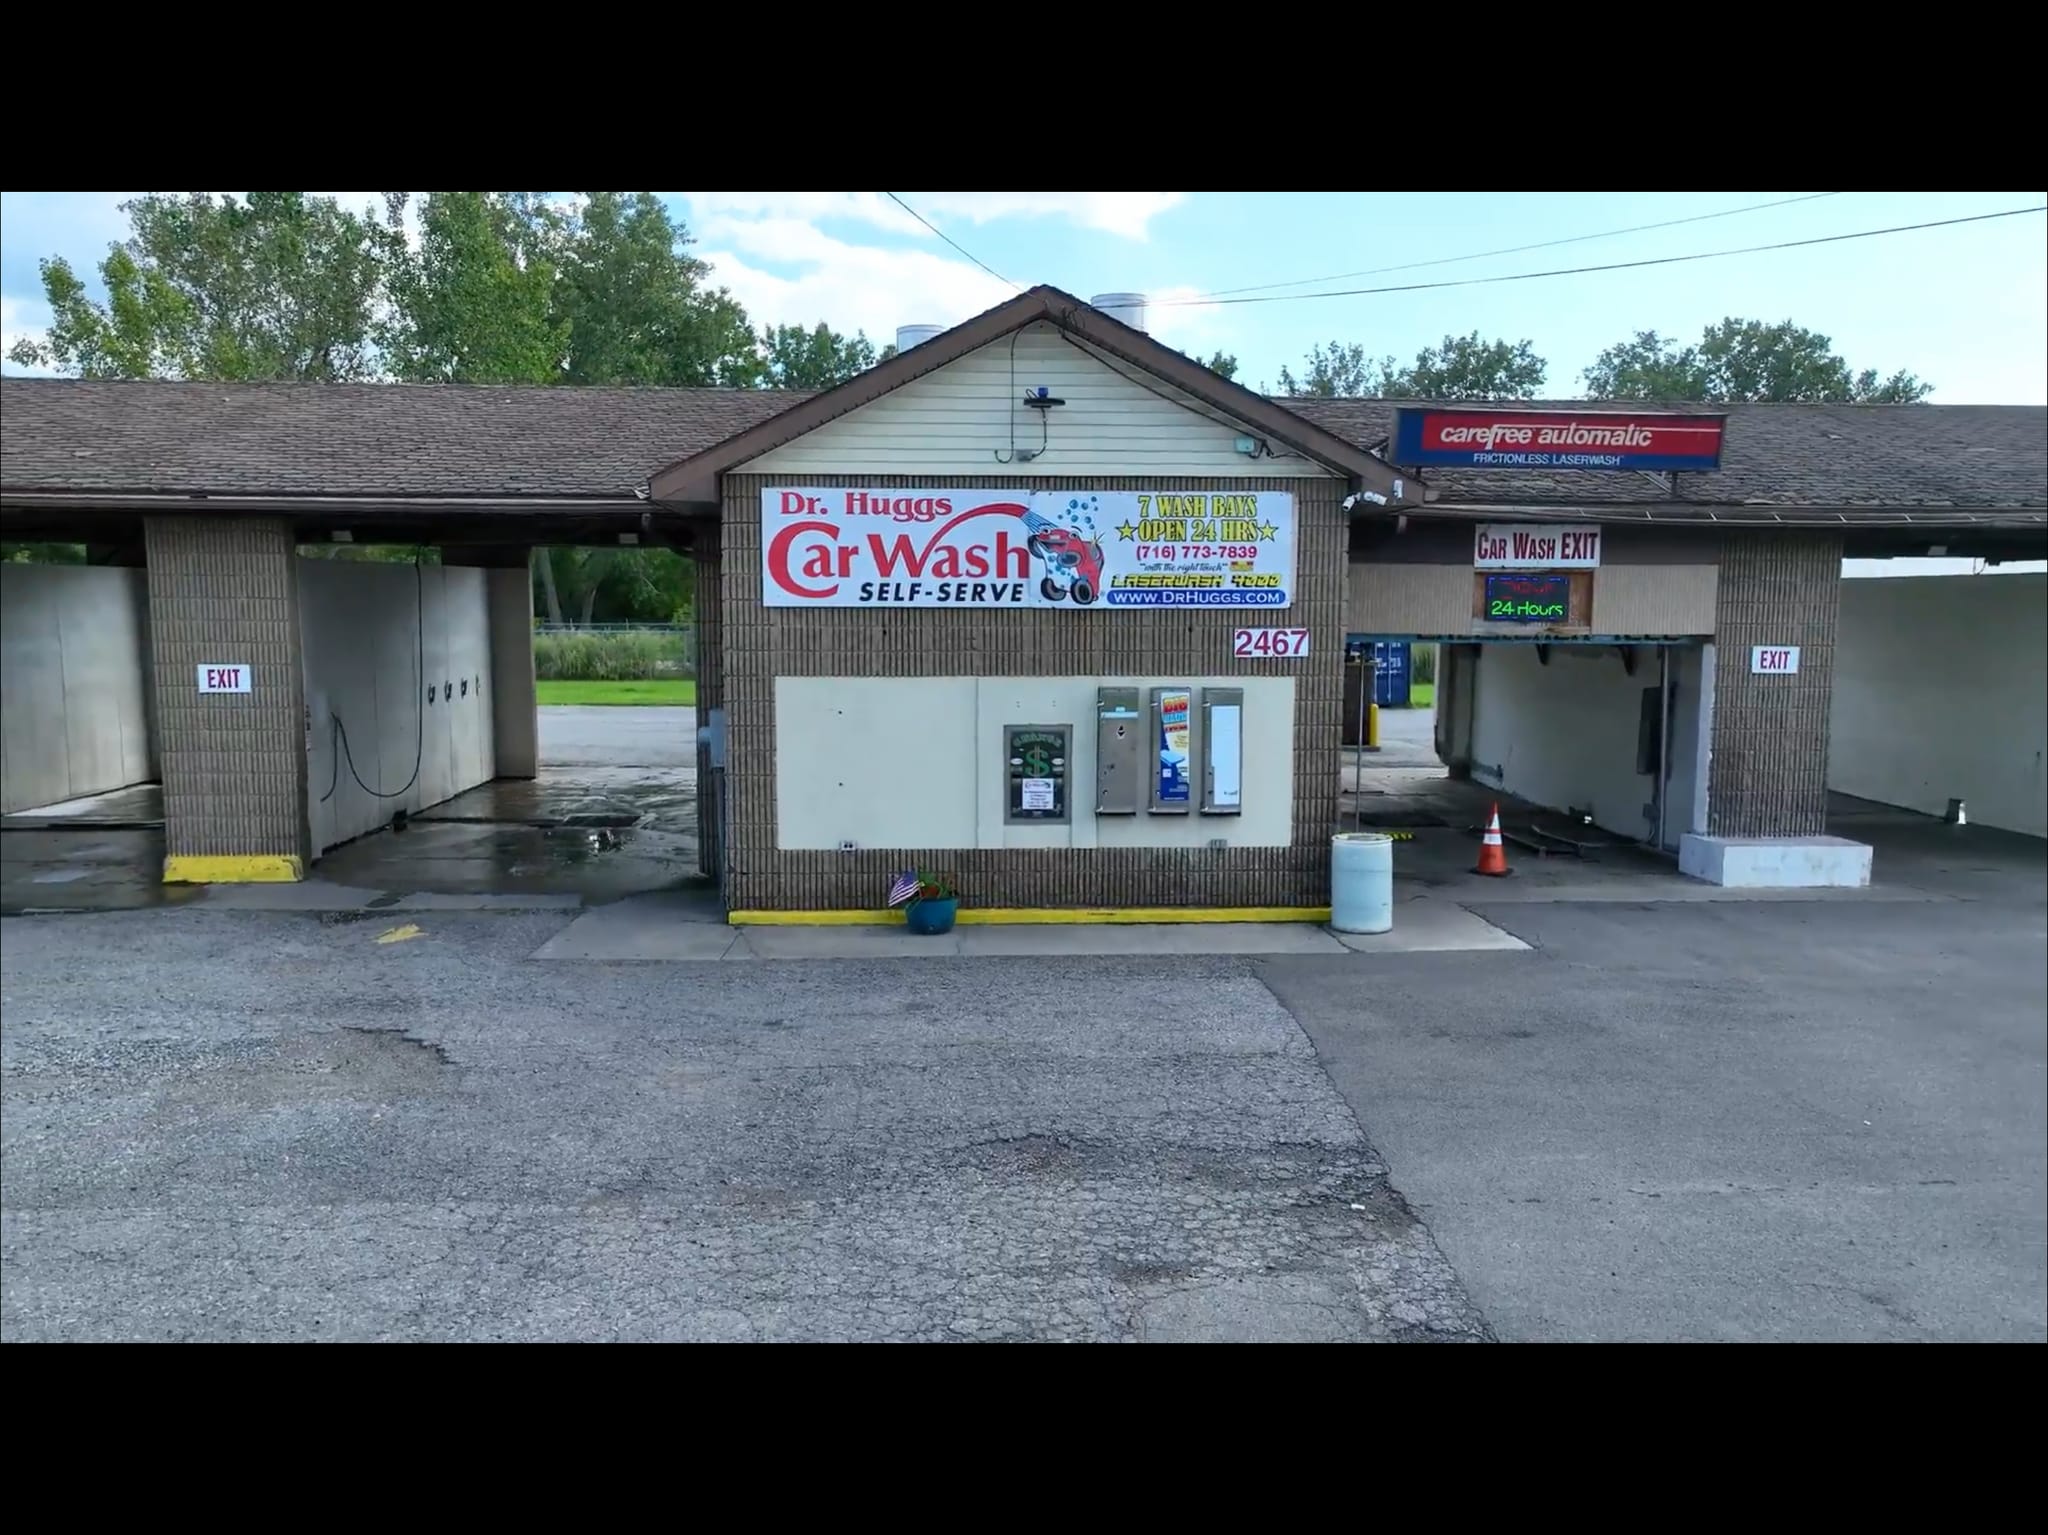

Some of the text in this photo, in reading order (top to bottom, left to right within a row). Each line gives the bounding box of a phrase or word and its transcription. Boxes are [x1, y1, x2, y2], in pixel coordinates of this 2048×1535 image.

[1440, 423, 1653, 450] carefree automatic
[1473, 452, 1620, 466] FRICTIONLESS LASERWASH
[780, 491, 952, 522] Dr. Huggs
[1138, 495, 1258, 518] 7 WASH BAYS
[1137, 519, 1259, 542] OPEN 24 HRS
[1136, 545, 1258, 561] (716) 773-7839
[1560, 532, 1599, 560] EXIT
[768, 521, 1030, 599] Car Wash
[1111, 573, 1225, 589] LASERWASH
[859, 582, 1024, 602] SELF-SERVE
[1491, 600, 1563, 616] 24 Hours
[1235, 630, 1308, 656] 2467
[1760, 650, 1791, 670] EXIT
[207, 669, 240, 689] EXIT
